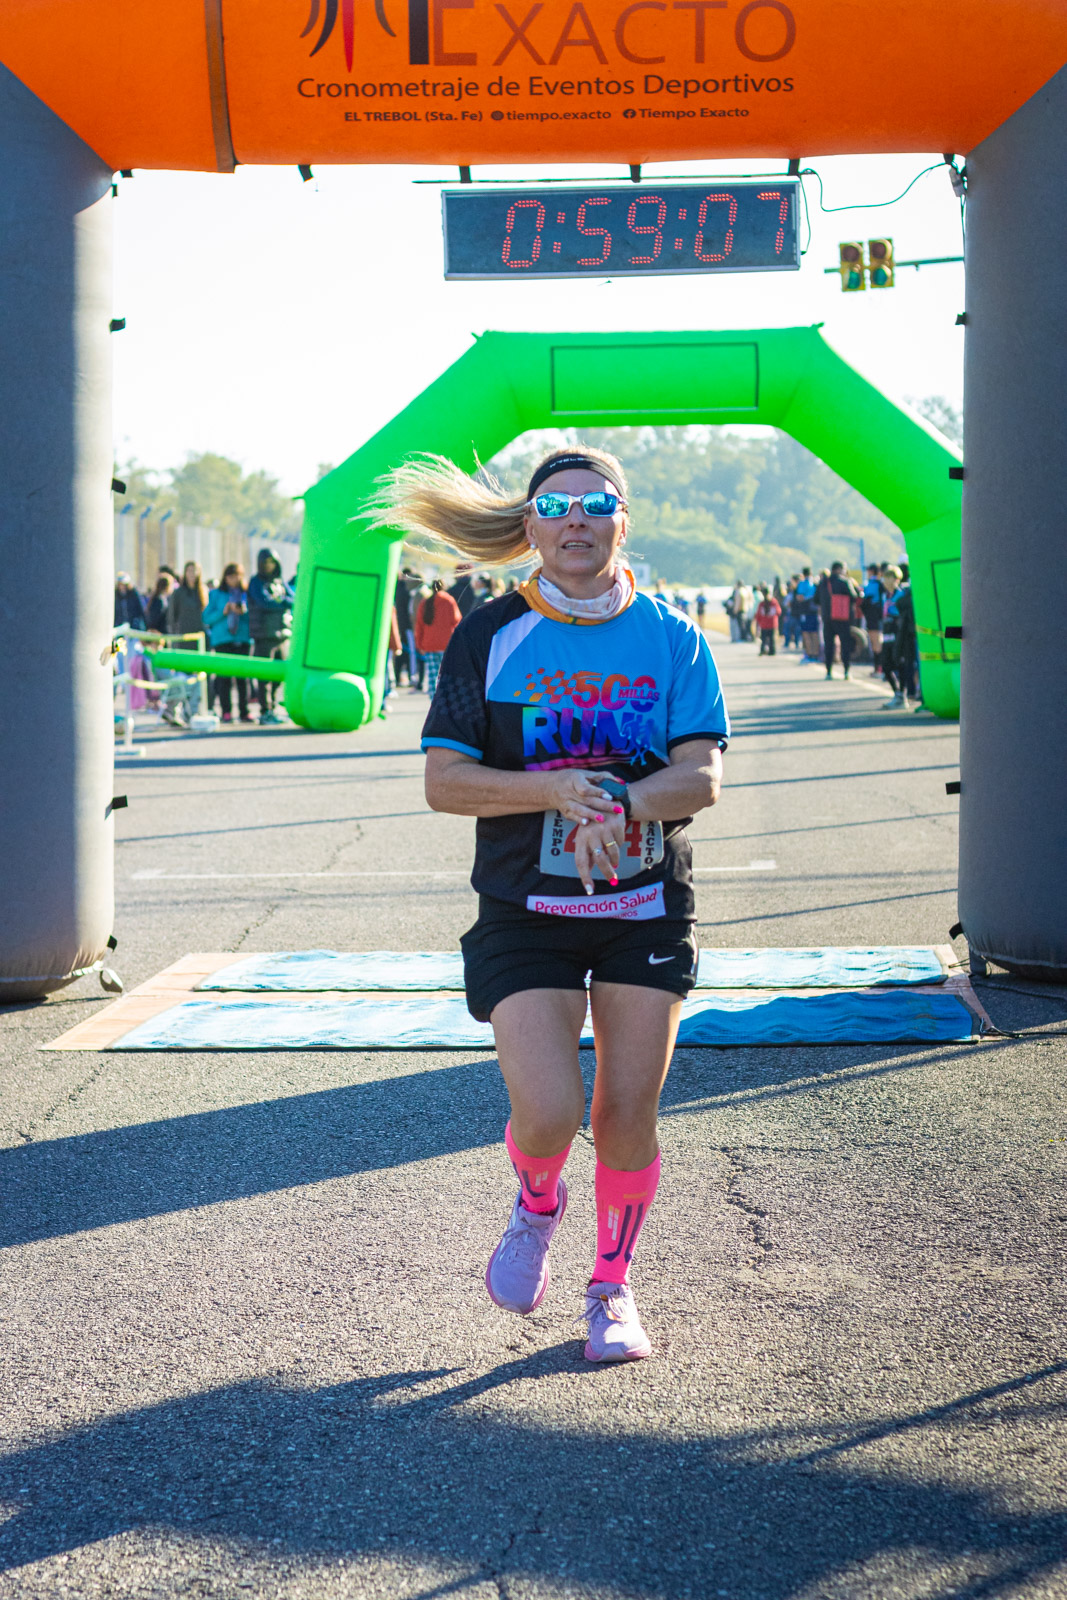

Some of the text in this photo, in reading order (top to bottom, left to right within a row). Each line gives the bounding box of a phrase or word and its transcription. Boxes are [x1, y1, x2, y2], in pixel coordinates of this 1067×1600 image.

[433, 0, 797, 66] EXACTO
[297, 73, 794, 102] Cronometraje de Eventos Deportivos
[344, 110, 483, 122] EL TREBOL (Sta. Fe)
[506, 109, 612, 122] tiempo.exacto
[639, 107, 750, 120] Tiempo Exacto
[501, 191, 789, 268] 0:59:07
[571, 670, 657, 713] 500
[618, 688, 661, 702] MILLAS
[535, 887, 658, 915] Prevención Salud
